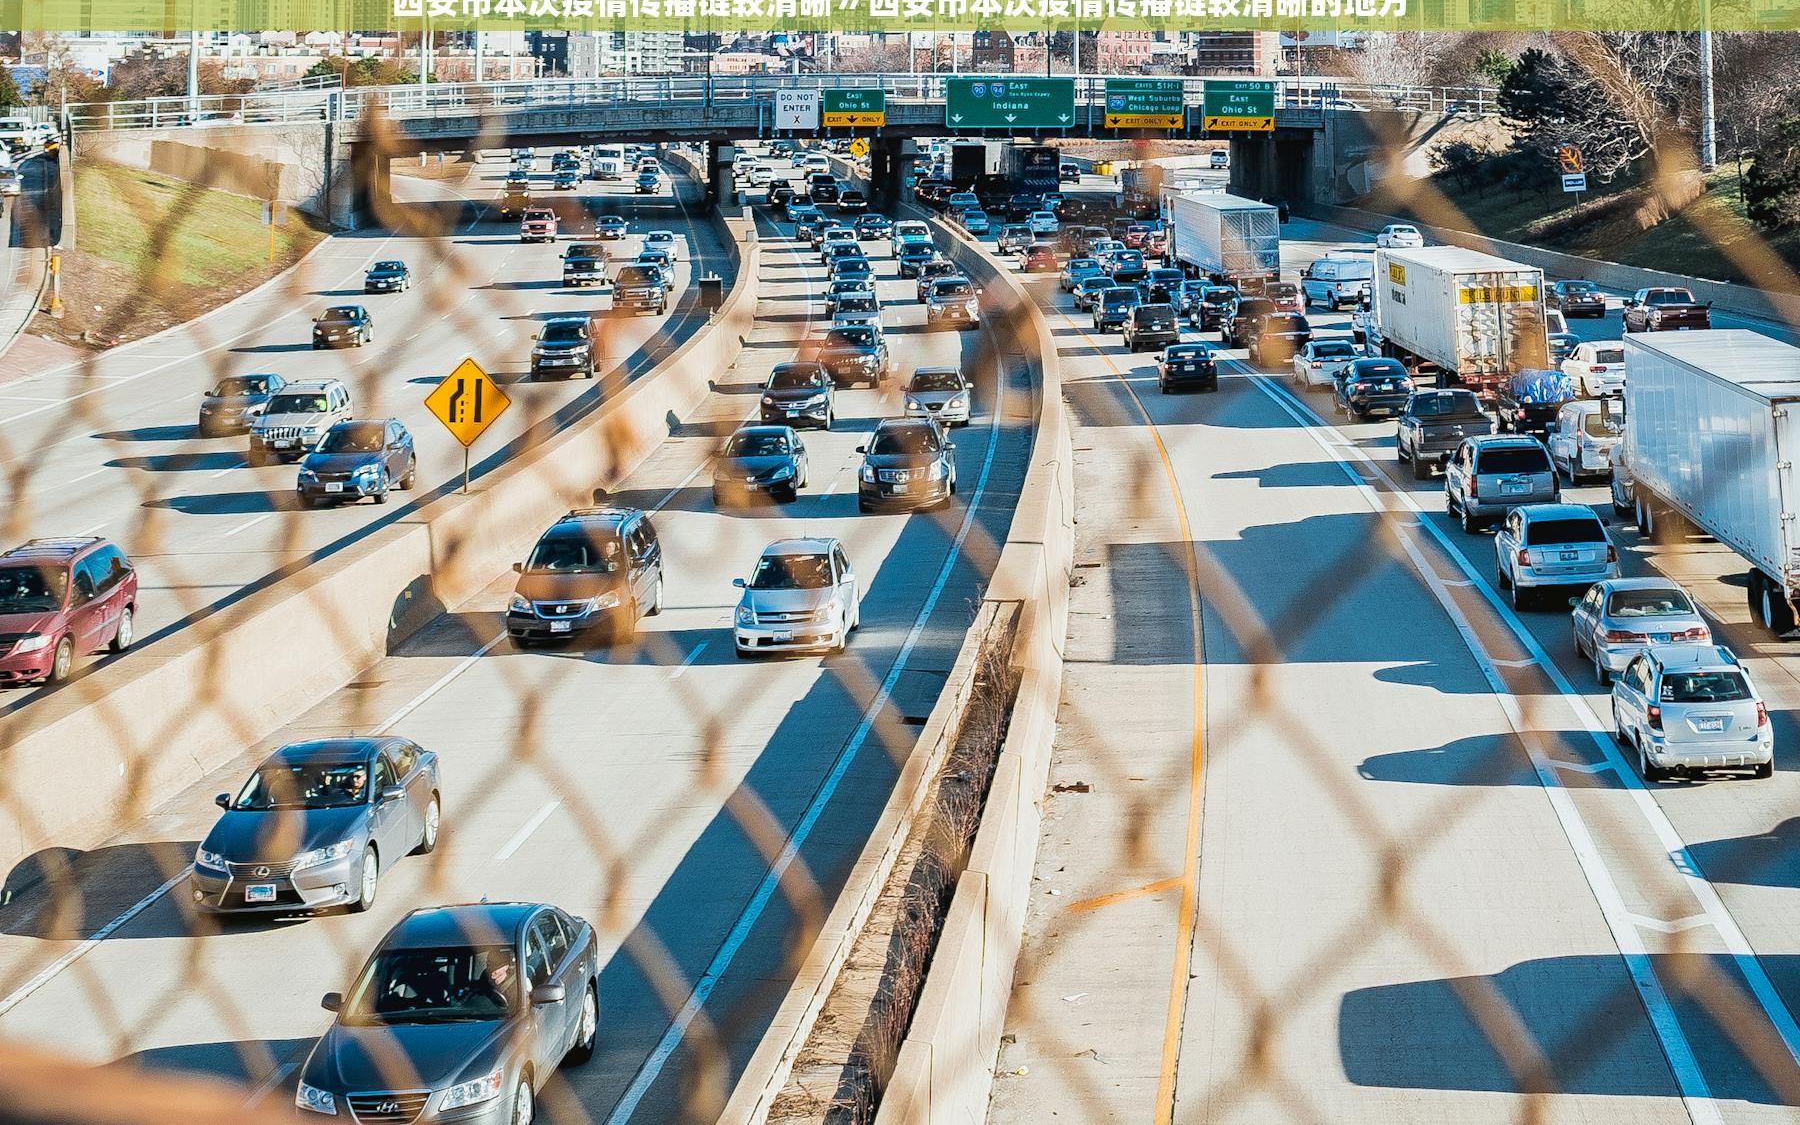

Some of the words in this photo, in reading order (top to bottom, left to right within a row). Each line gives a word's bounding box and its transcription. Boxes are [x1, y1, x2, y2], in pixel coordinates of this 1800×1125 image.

[973, 86, 984, 94] 90
[993, 86, 1003, 94] 94
[1249, 82, 1261, 90] 50
[780, 93, 792, 101] DO
[796, 93, 814, 101] NOT
[1128, 94, 1146, 102] West
[1149, 94, 1181, 102] Suburbs
[1229, 95, 1249, 103] EAST
[783, 104, 811, 112] ENTER
[860, 101, 870, 109] St
[992, 101, 1029, 110] Indiana
[1128, 103, 1159, 112] Chicago
[1162, 104, 1180, 112] Loop
[1221, 105, 1243, 114] Ohio
[1247, 105, 1258, 114] St
